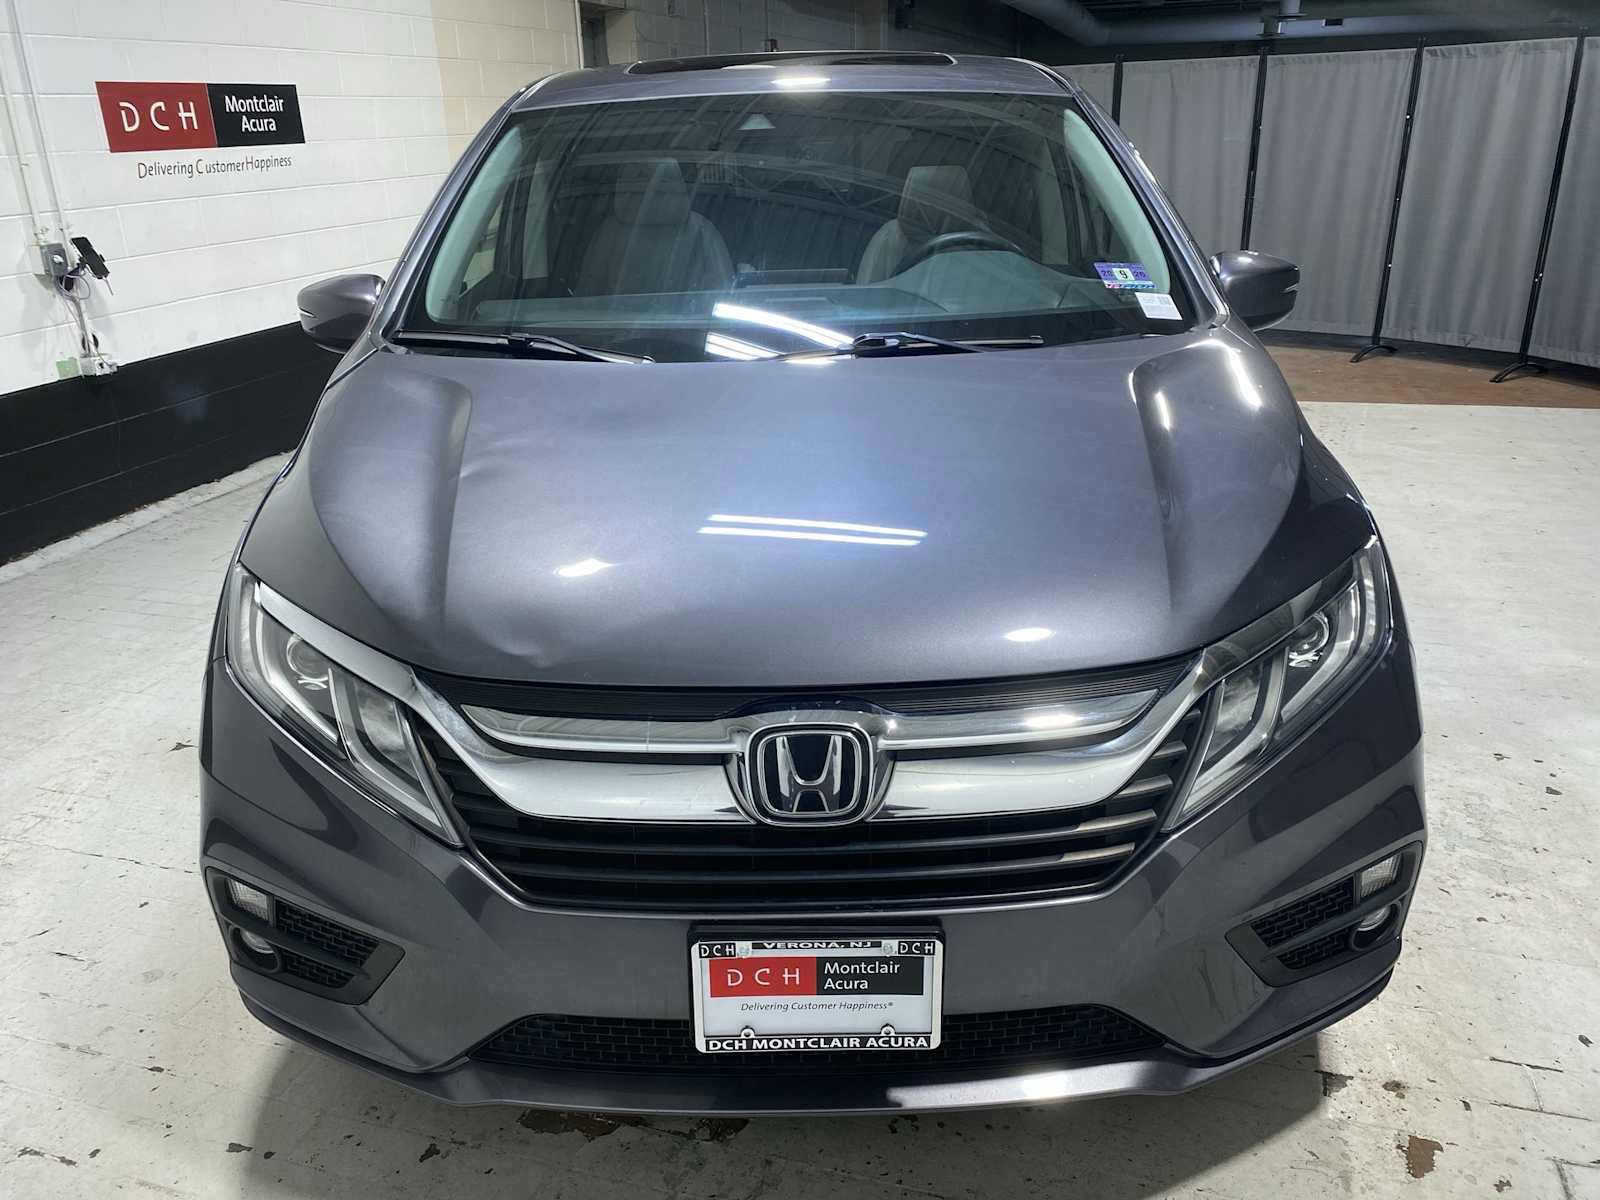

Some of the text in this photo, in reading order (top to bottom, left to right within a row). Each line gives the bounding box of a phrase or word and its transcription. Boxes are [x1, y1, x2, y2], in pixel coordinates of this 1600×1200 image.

[224, 95, 284, 113] Montclair
[241, 115, 277, 132] Acura
[137, 161, 194, 179] Delivering
[700, 944, 735, 957] DCH
[900, 943, 935, 954] DCH
[824, 961, 900, 975] Montclair
[727, 968, 800, 987] DCH
[824, 978, 869, 990] Acura
[740, 1002, 789, 1013] Delivering
[791, 1002, 837, 1011] Customer
[708, 1036, 928, 1050] DCH MONTCLAIR ACURA
